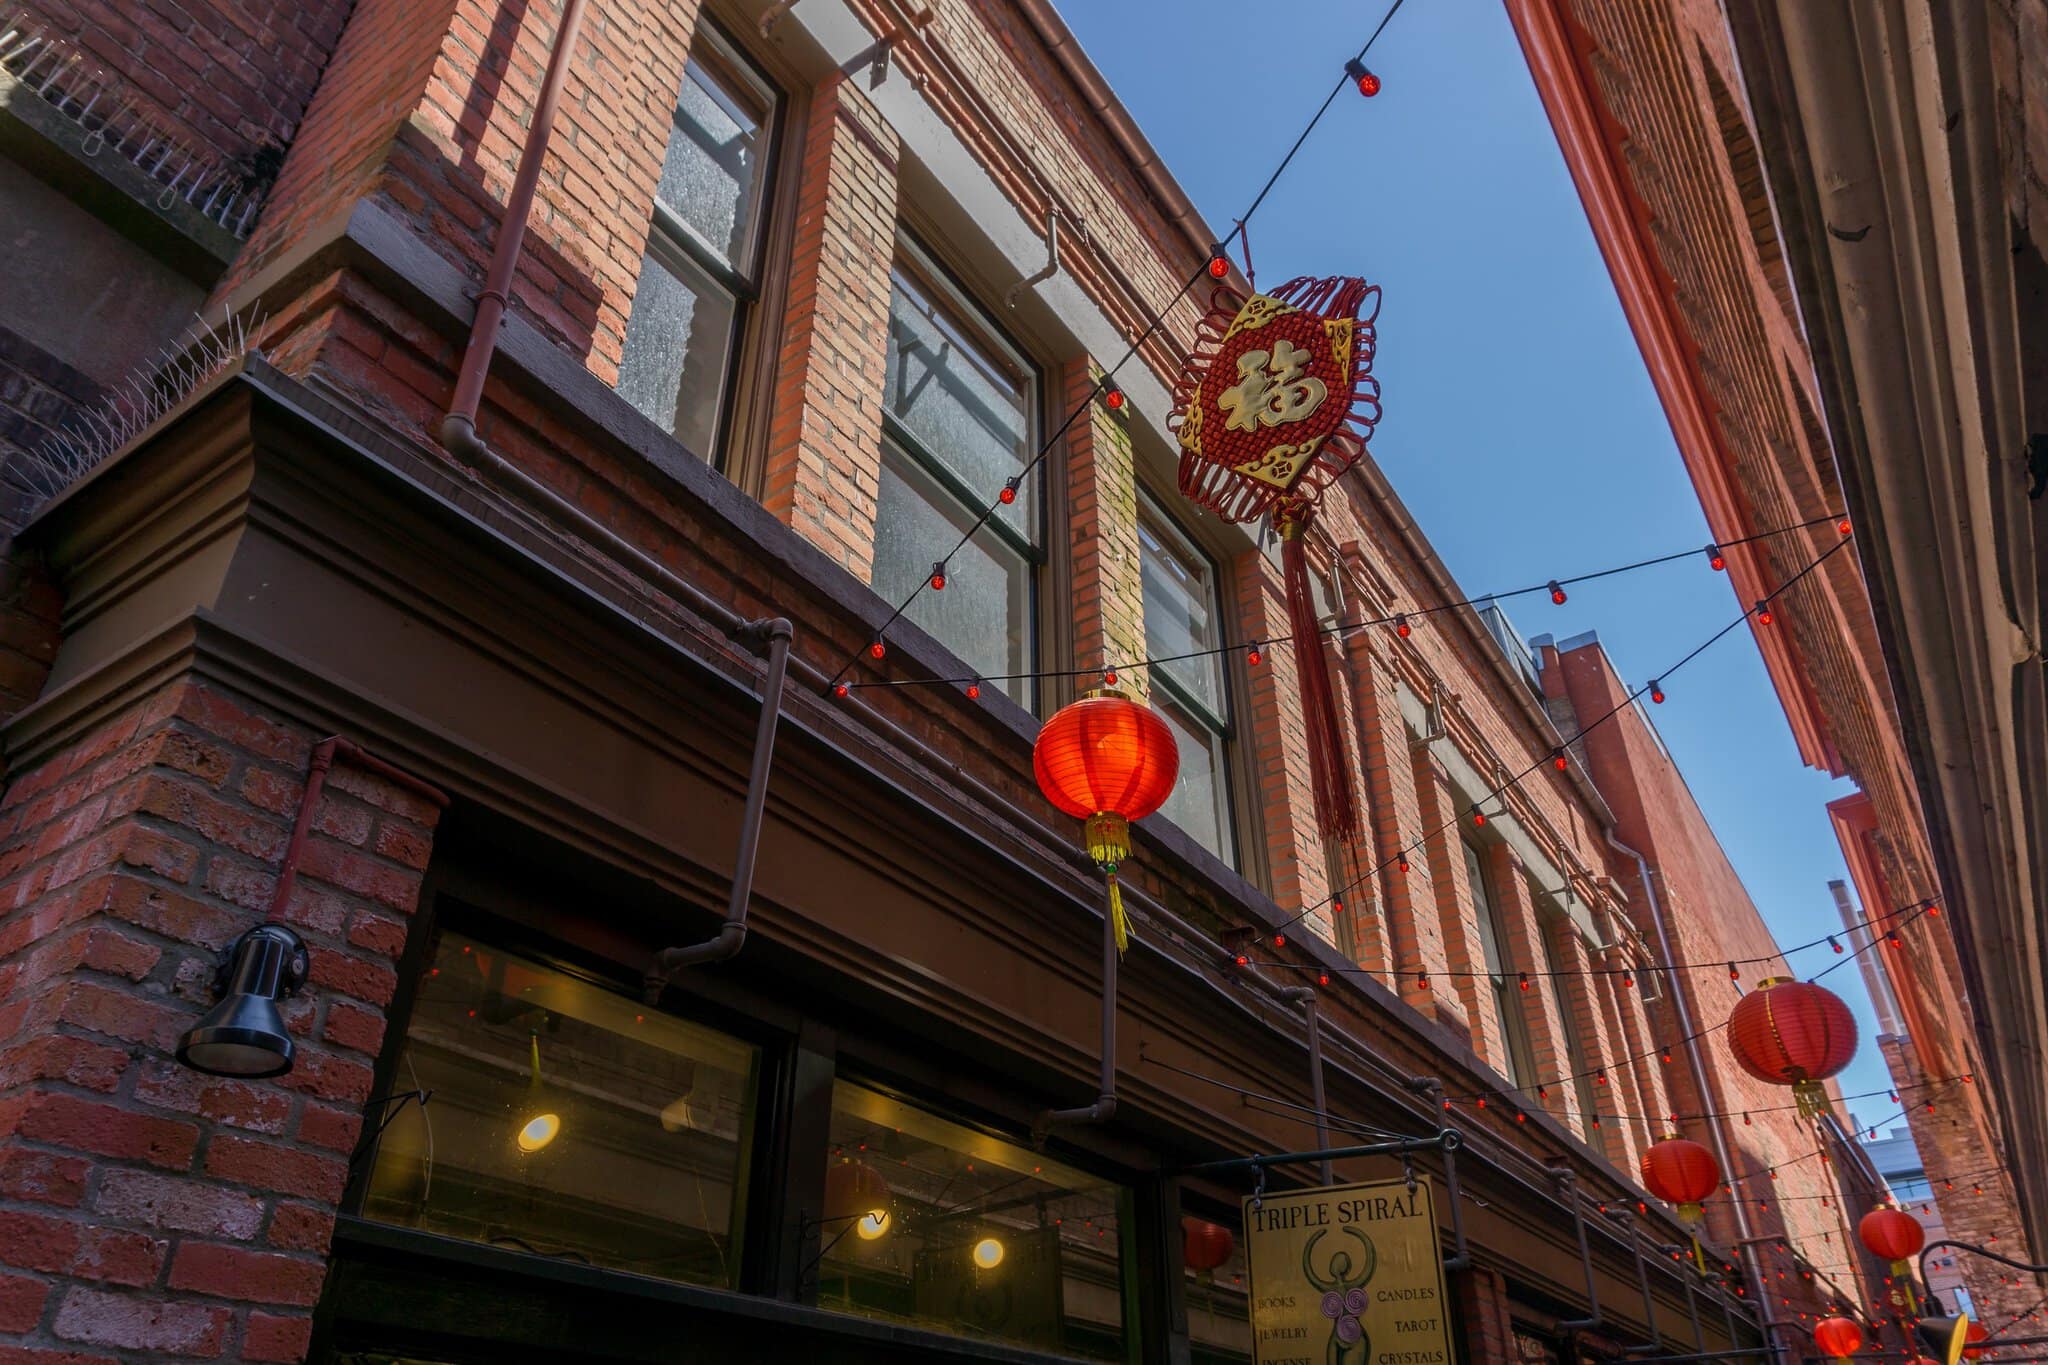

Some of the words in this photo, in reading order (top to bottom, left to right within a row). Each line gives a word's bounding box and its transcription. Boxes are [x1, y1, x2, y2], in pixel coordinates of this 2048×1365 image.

[1217, 339, 1328, 432] 福
[1252, 1203, 1329, 1232] TRIPLE
[1337, 1195, 1423, 1224] SPIRAL
[1377, 1288, 1434, 1302] CANDLES
[1257, 1297, 1296, 1310] BOOKS
[1395, 1319, 1437, 1333] TAROT
[1260, 1327, 1308, 1344] JEWELRY
[1378, 1351, 1444, 1365] CRYSTALS
